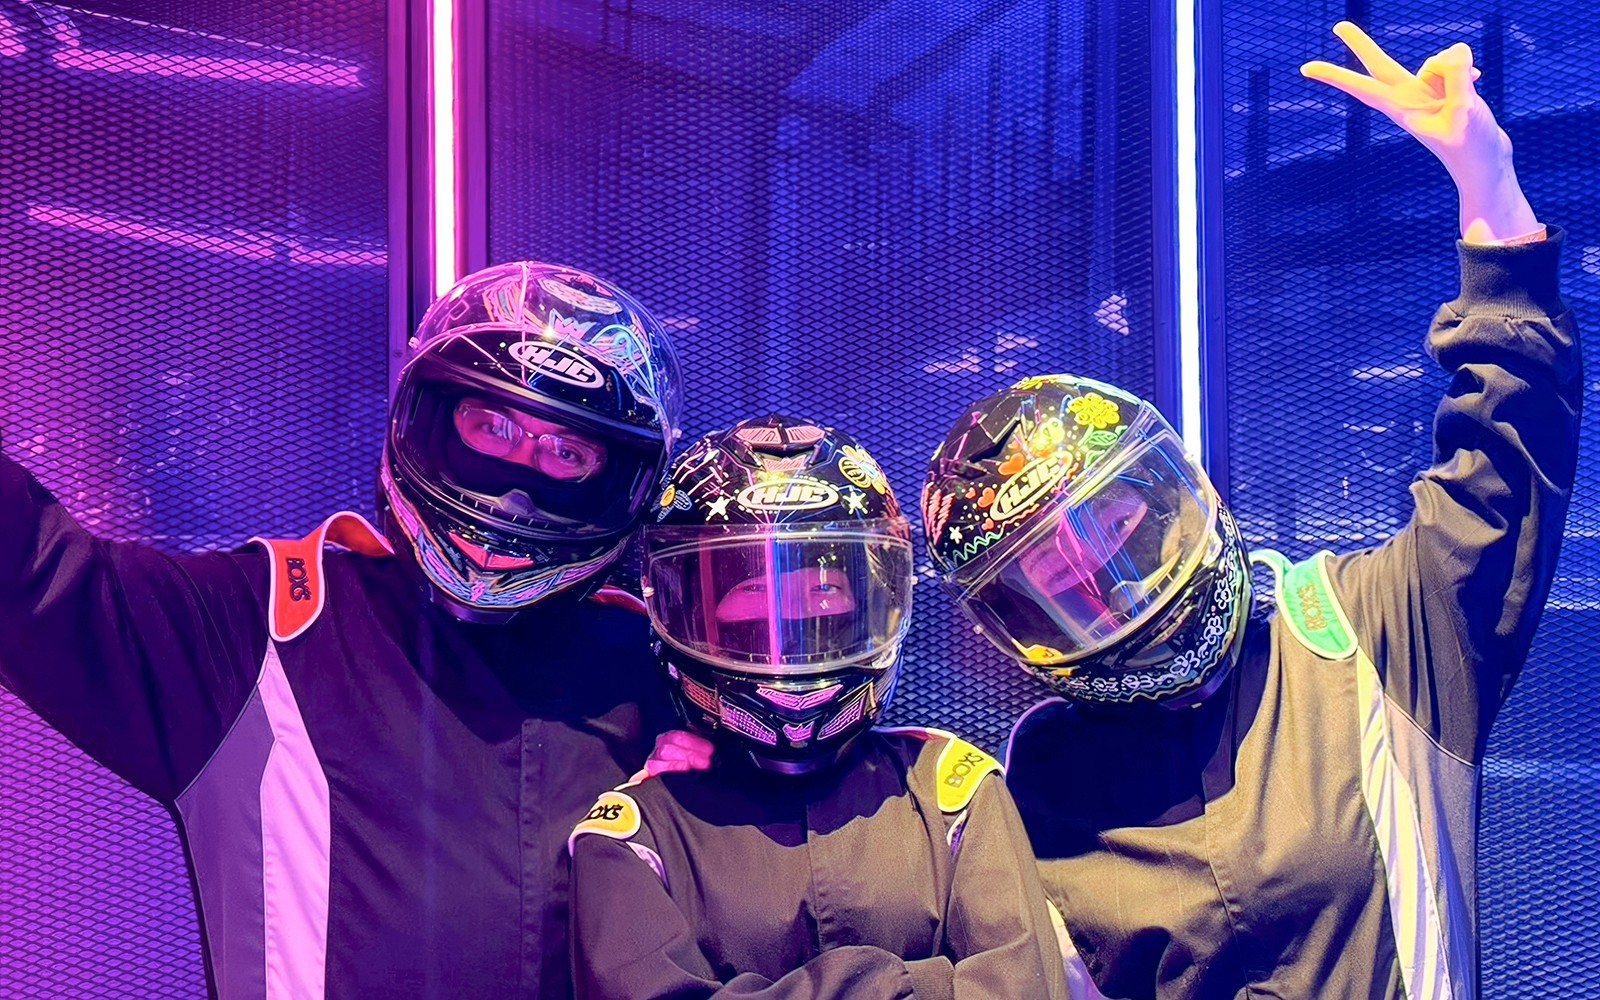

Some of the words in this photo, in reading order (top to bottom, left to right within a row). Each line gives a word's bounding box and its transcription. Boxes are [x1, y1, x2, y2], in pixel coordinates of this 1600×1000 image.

[519, 345, 595, 383] HJC
[752, 486, 828, 505] HJC
[1000, 455, 1062, 514] HJC
